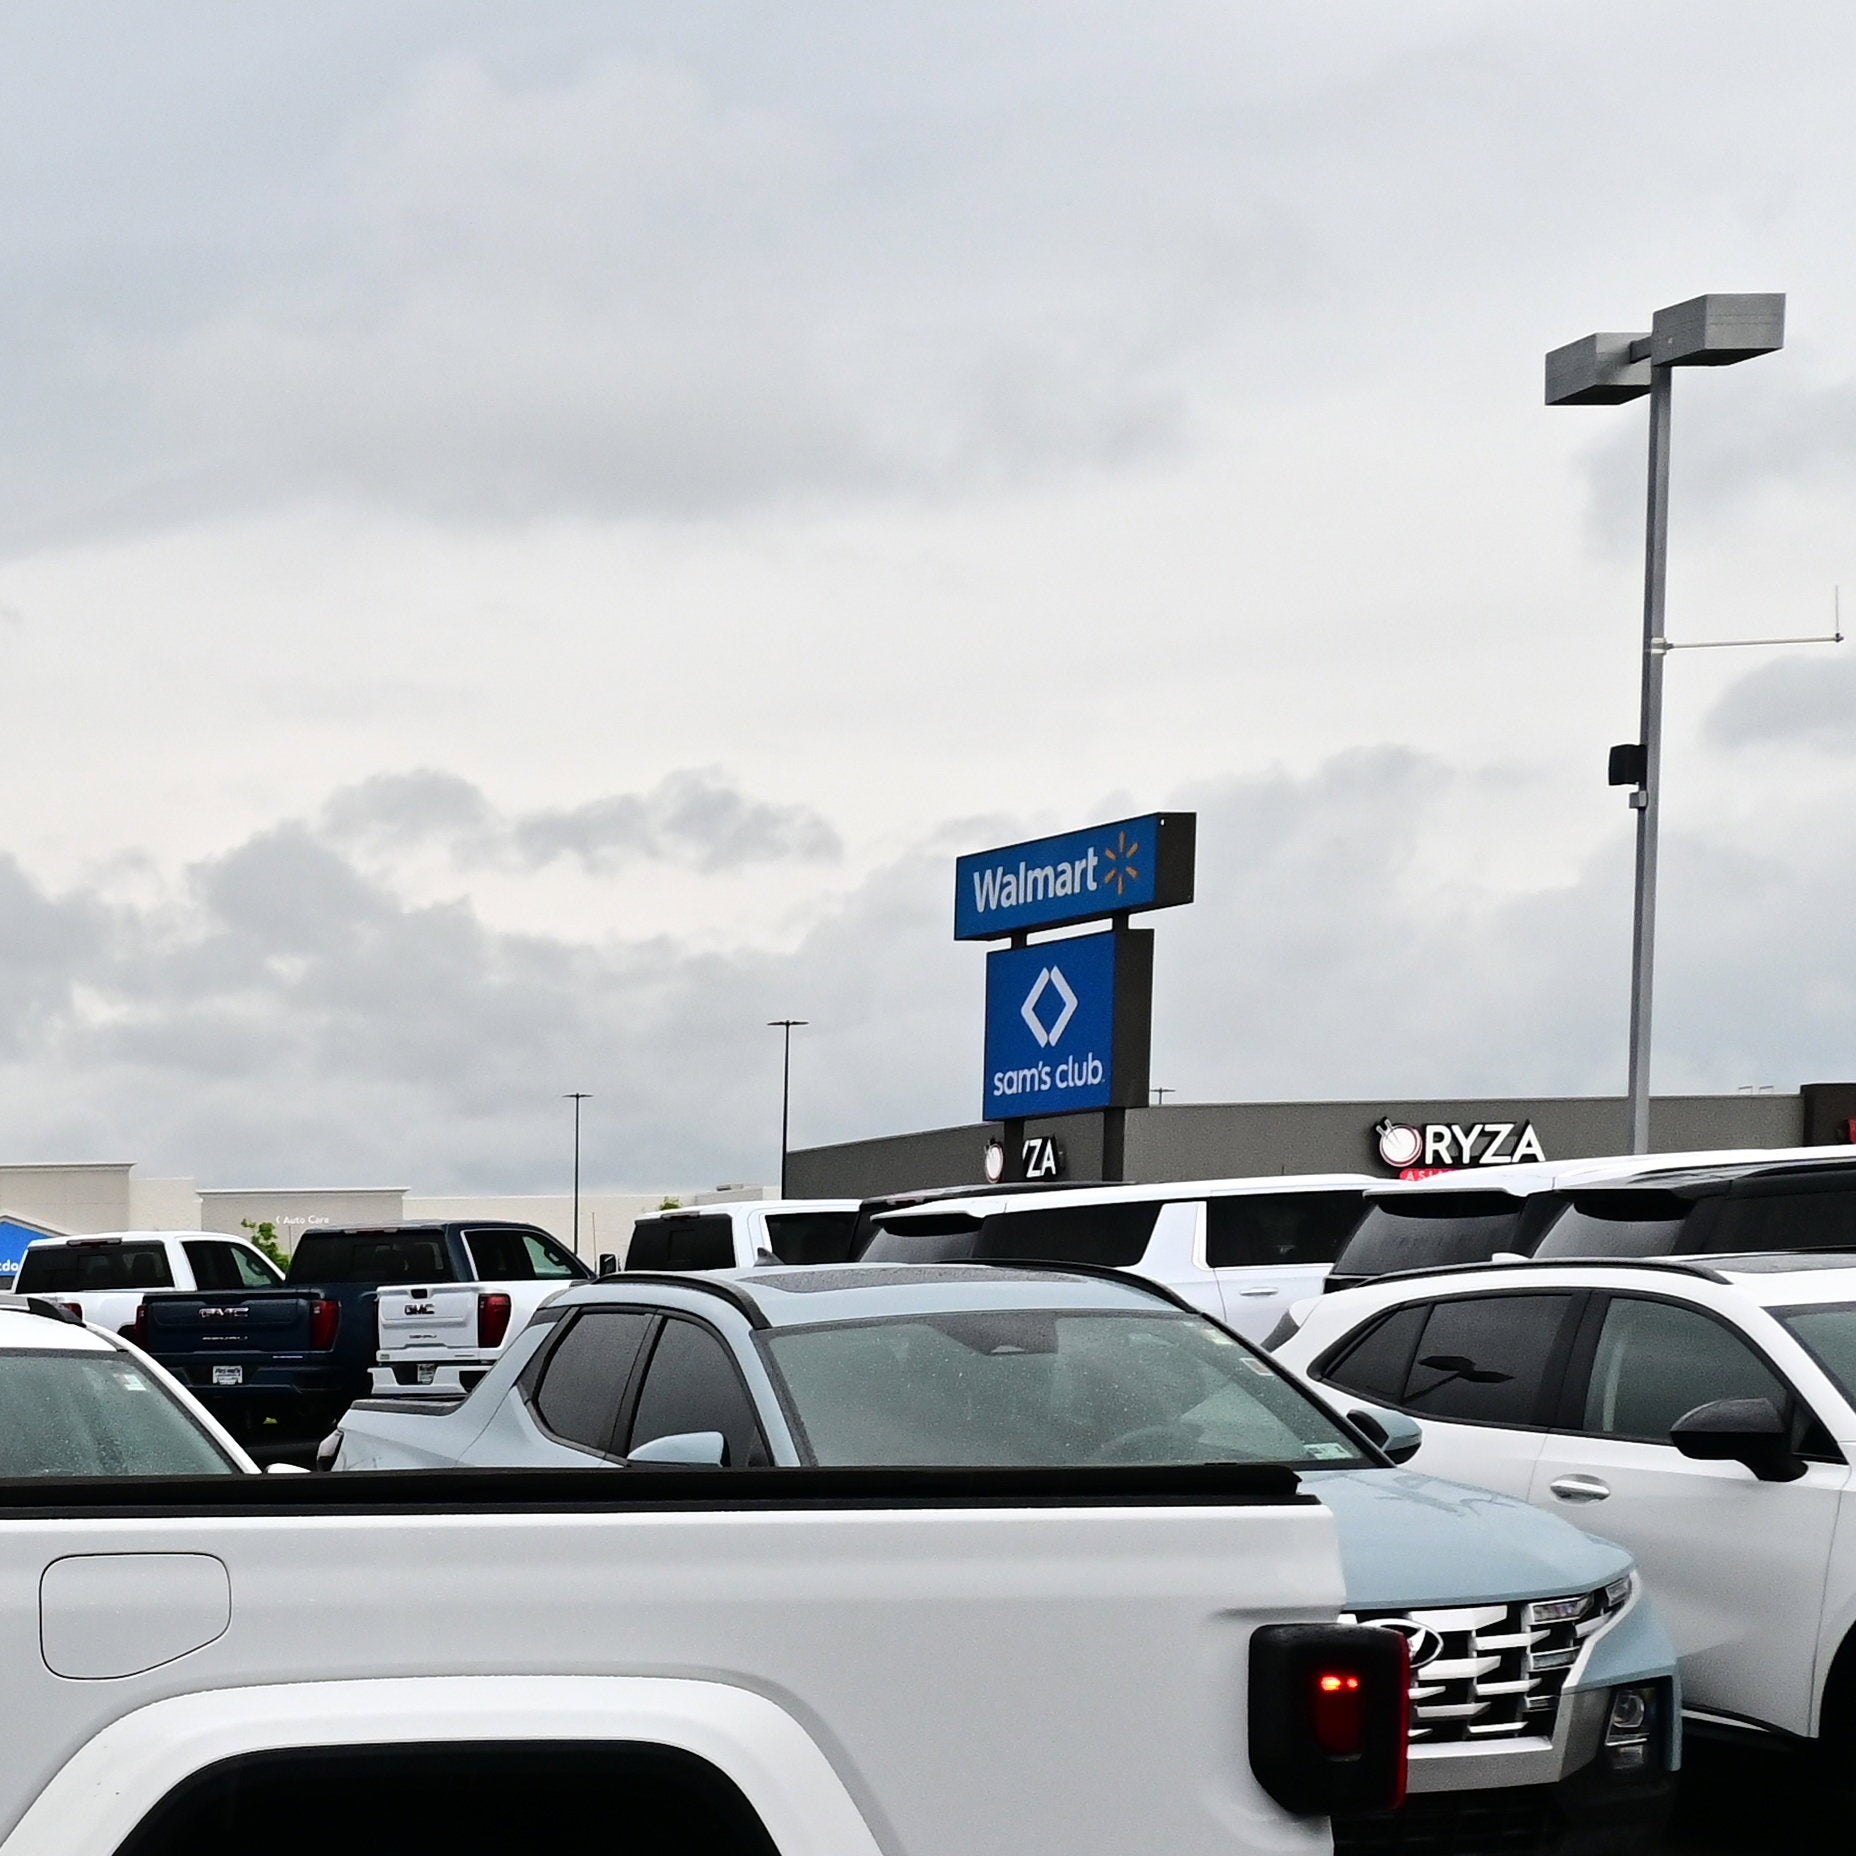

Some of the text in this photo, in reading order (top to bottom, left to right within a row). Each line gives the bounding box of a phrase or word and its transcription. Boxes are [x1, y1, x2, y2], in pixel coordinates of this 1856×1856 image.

[973, 847, 1099, 913] Walmart
[993, 1052, 1104, 1096] sam's club
[283, 1215, 330, 1225] Auto Care
[404, 1304, 435, 1316] GMC
